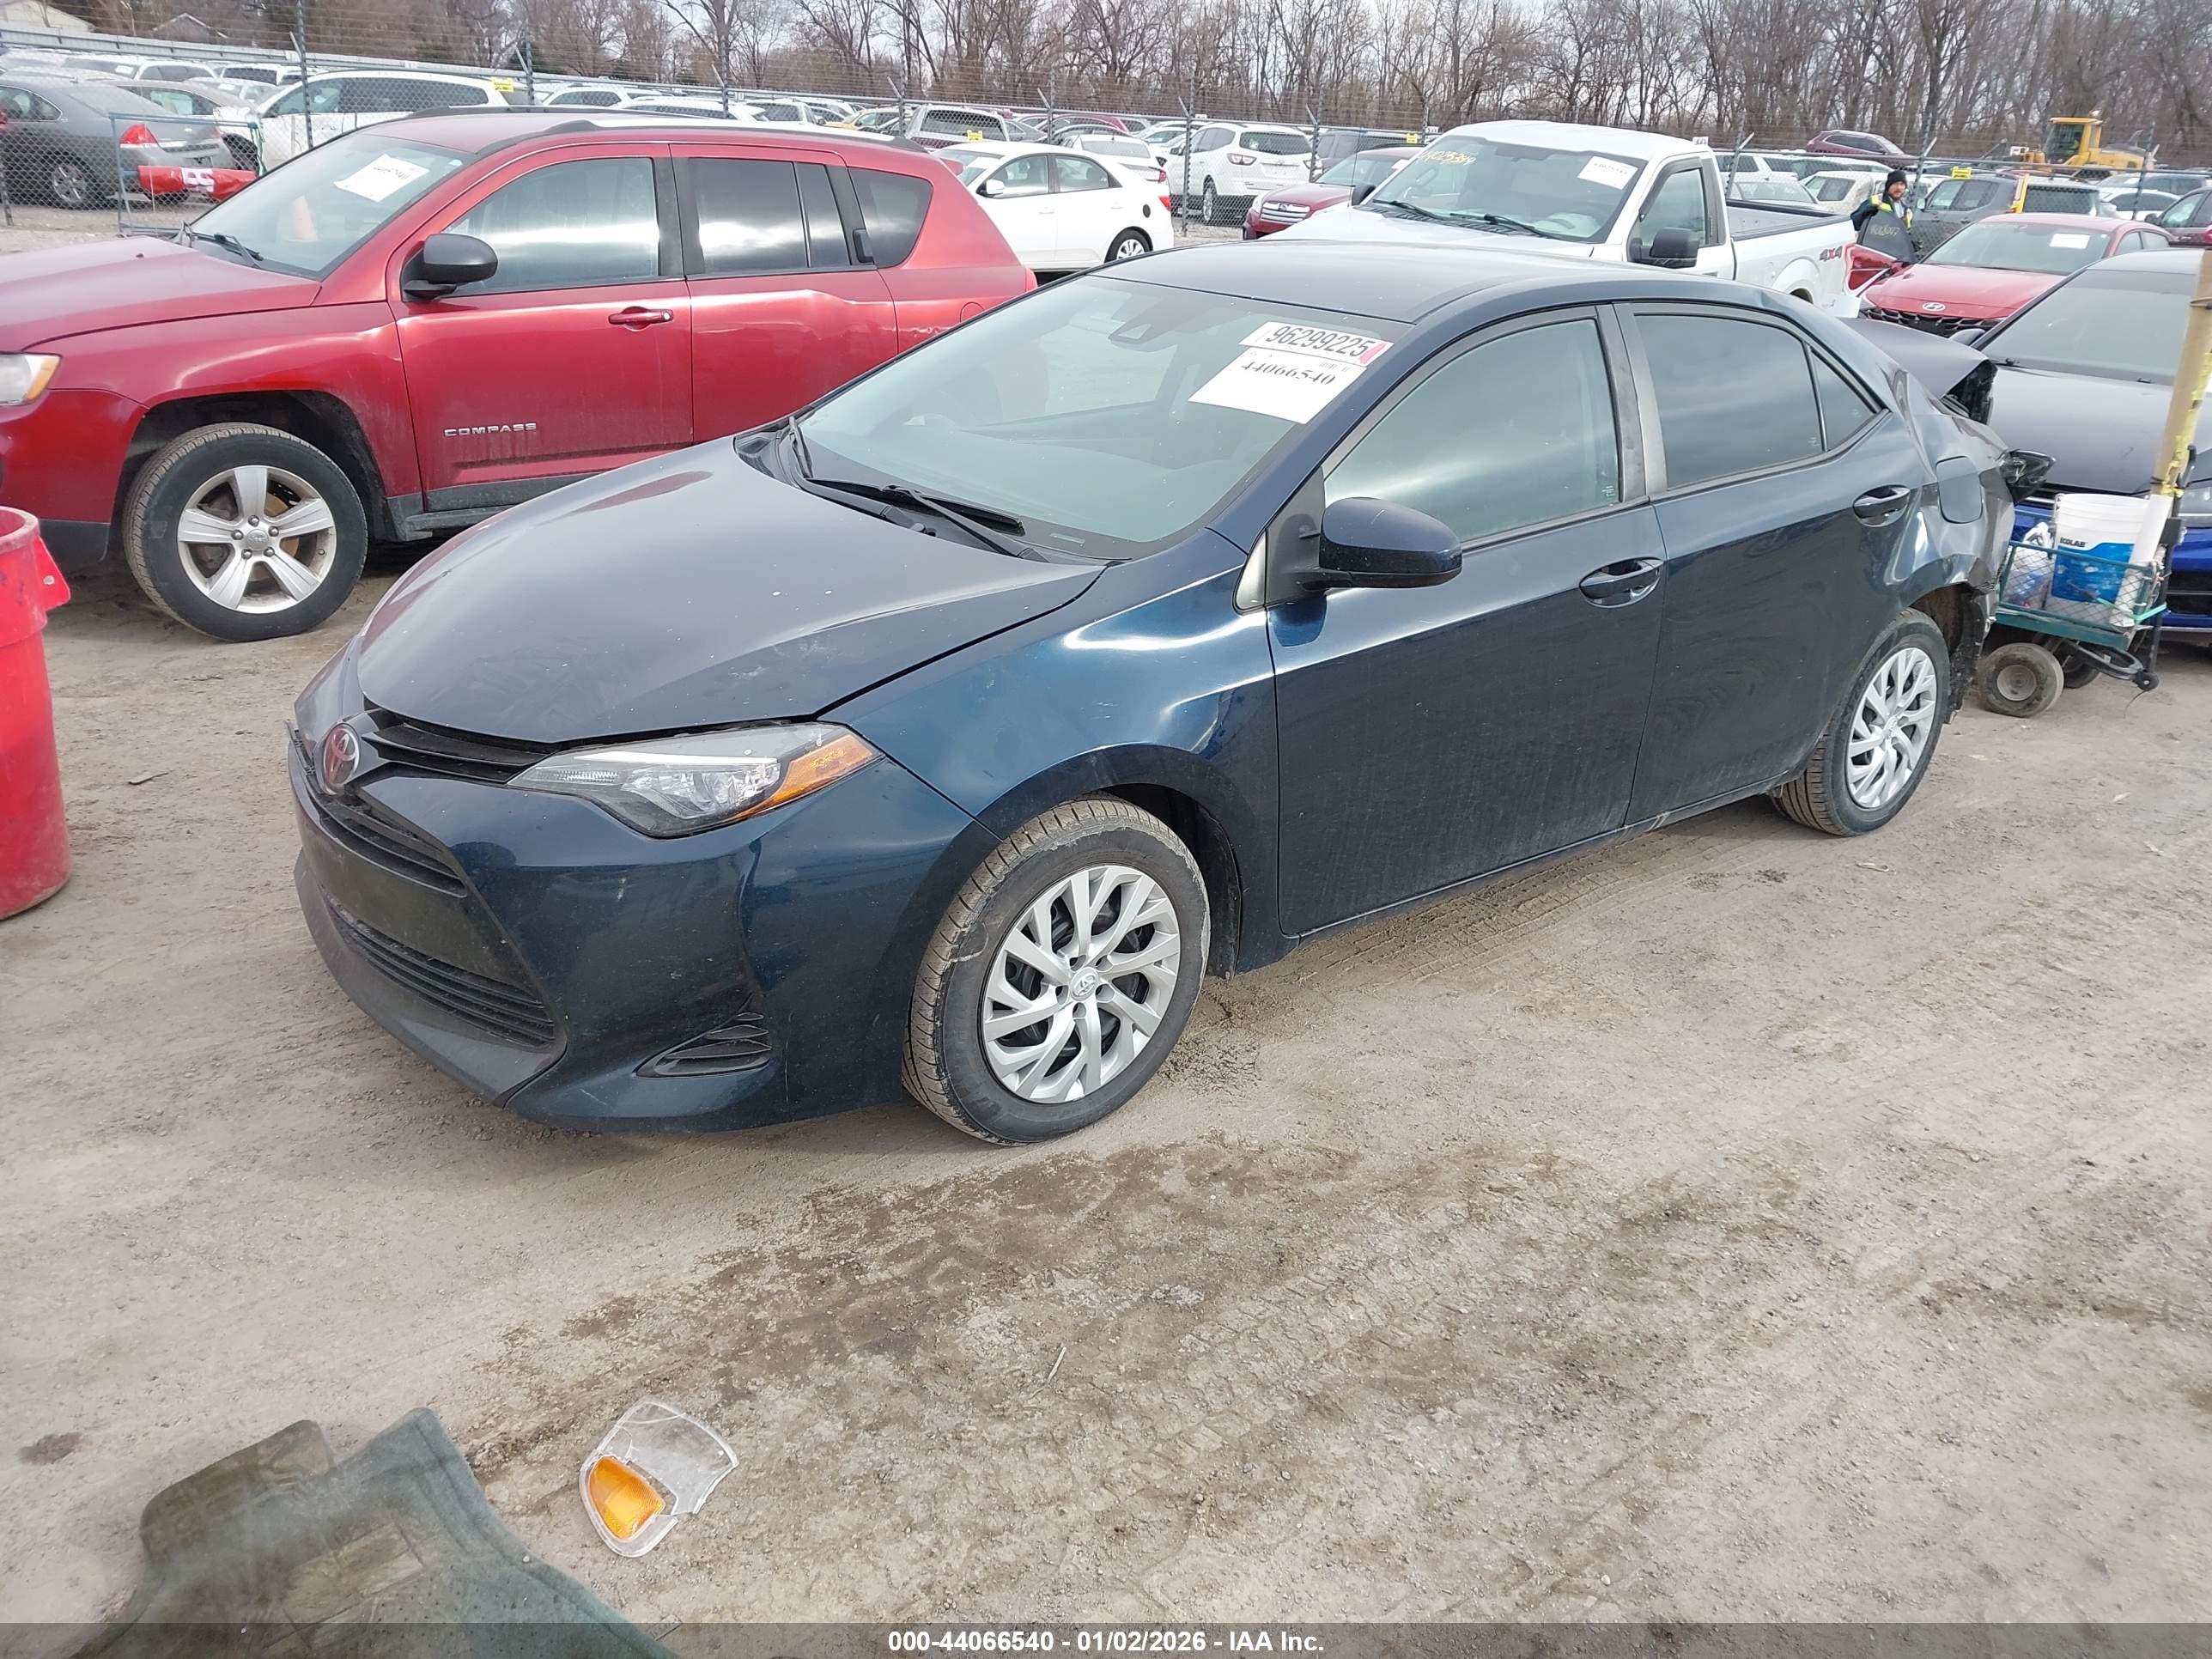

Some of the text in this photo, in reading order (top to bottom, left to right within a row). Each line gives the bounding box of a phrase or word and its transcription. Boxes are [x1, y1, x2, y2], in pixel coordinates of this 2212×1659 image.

[1266, 325, 1376, 357] 96299225
[1241, 361, 1336, 385] 44066540
[444, 422, 537, 436] COMPASS
